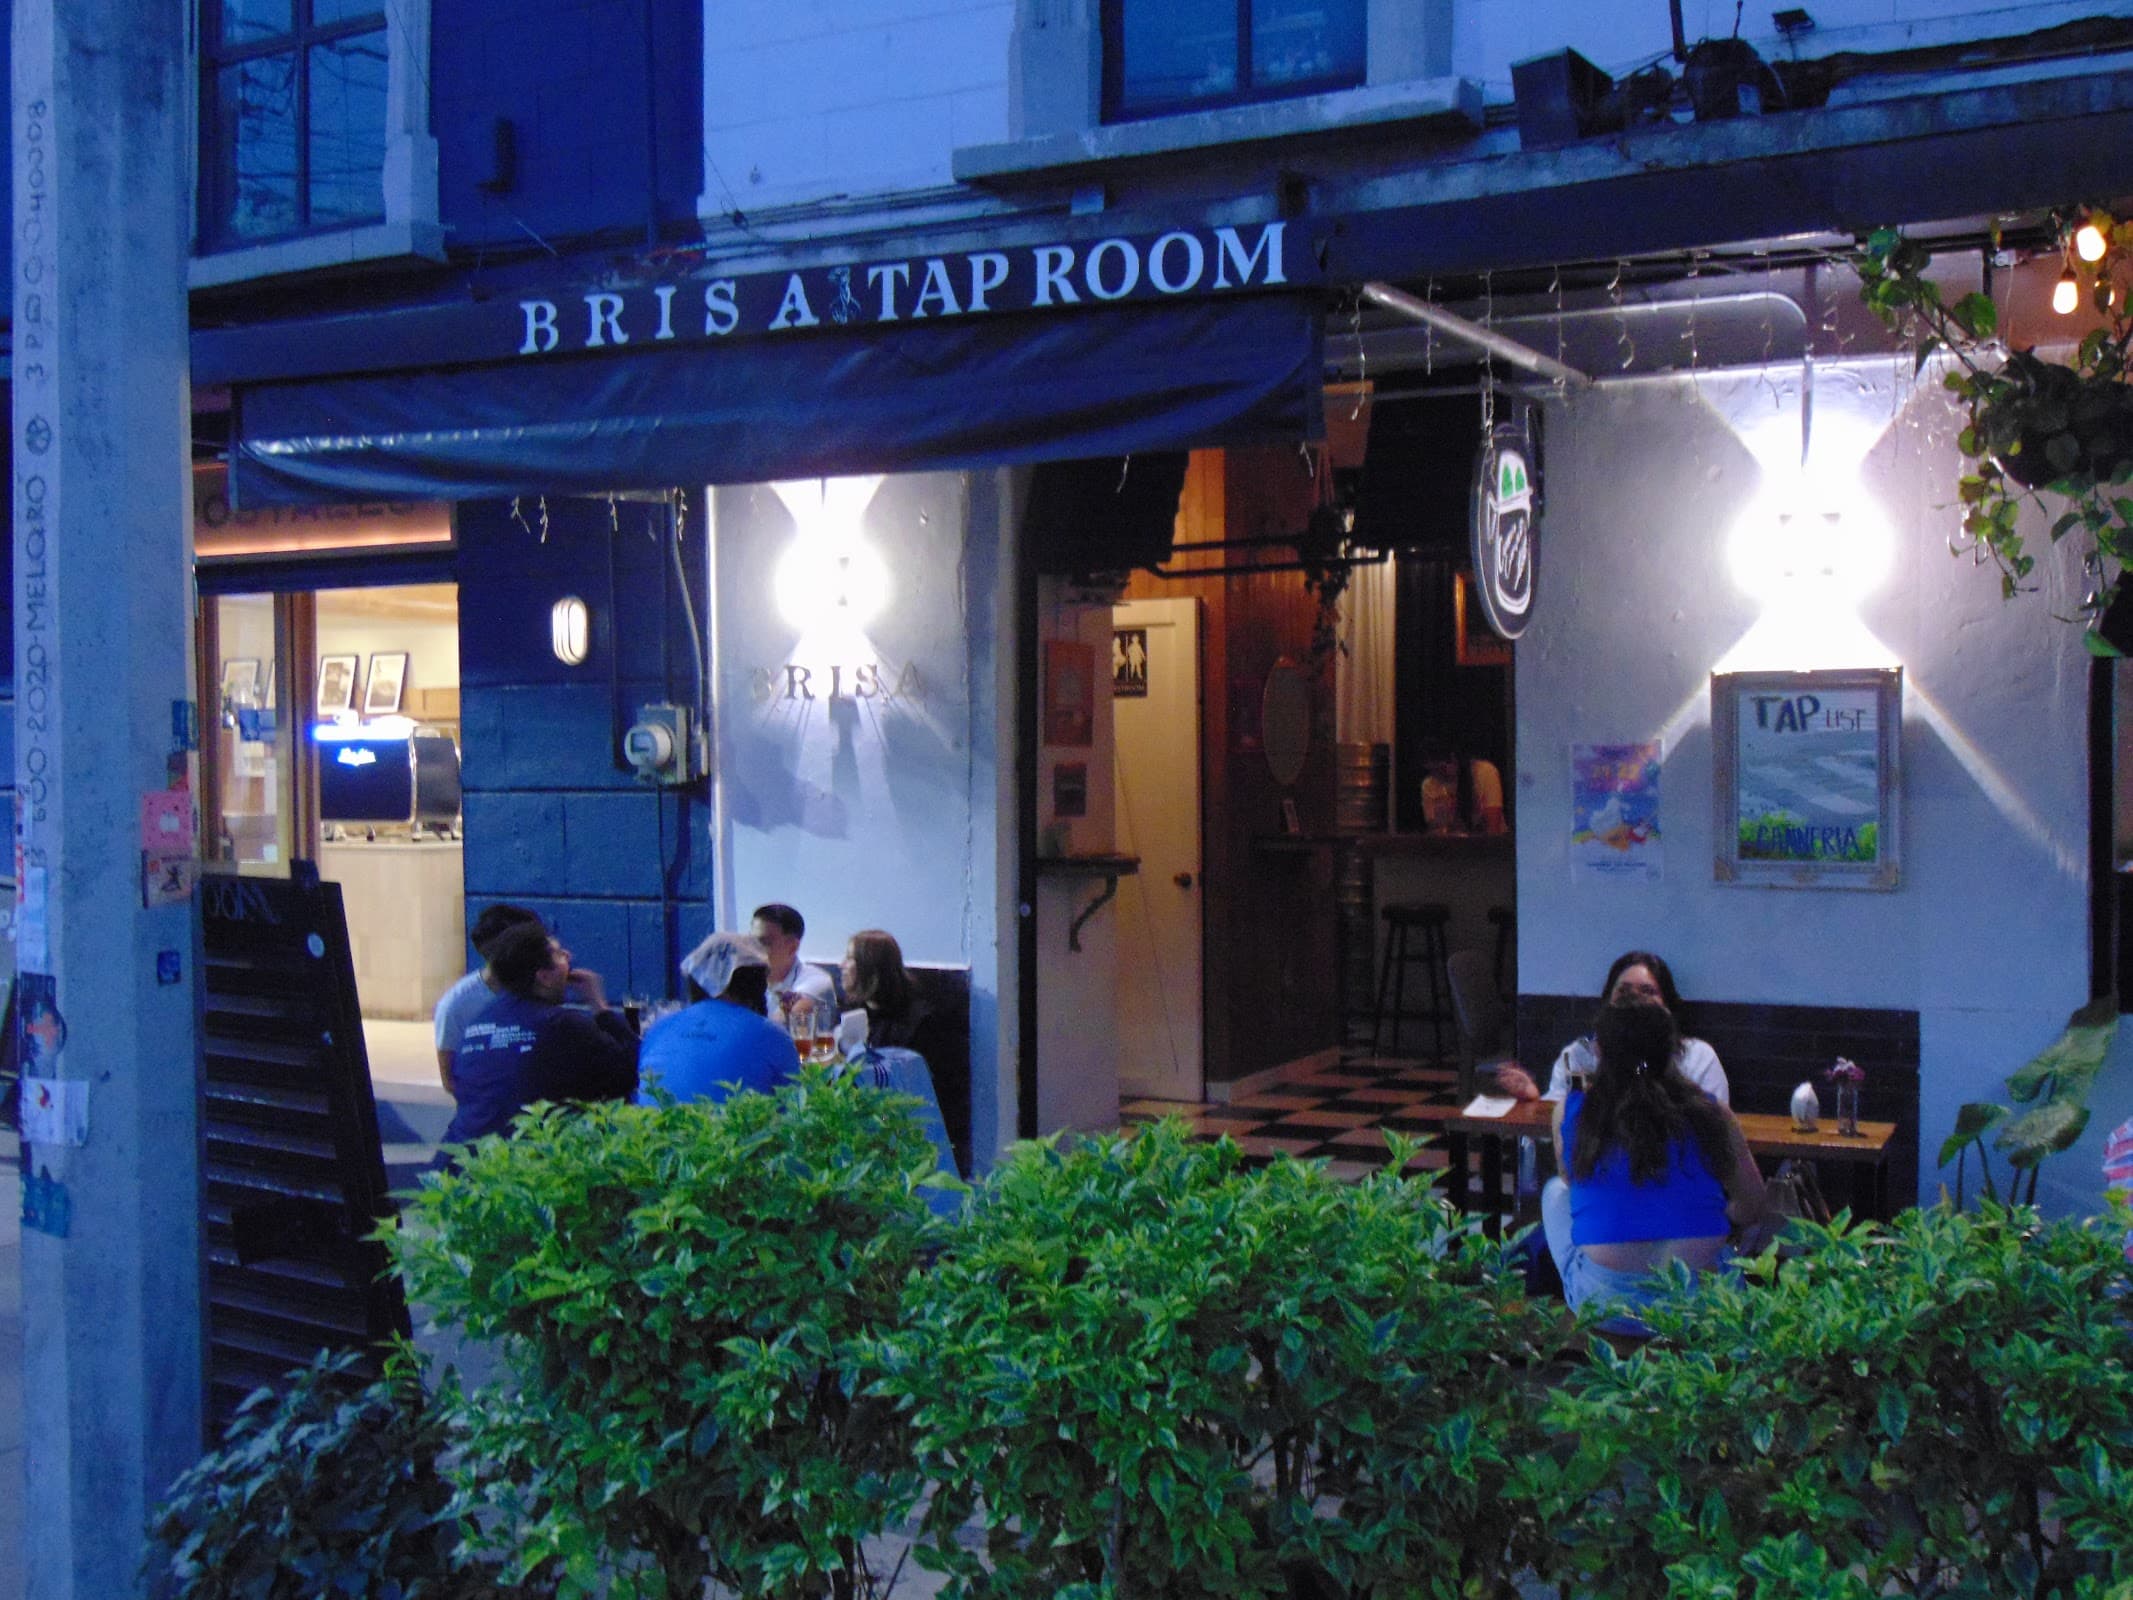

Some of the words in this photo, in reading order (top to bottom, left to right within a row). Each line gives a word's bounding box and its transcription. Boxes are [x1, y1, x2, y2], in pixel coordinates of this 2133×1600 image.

[519, 274, 820, 355] BRISA
[868, 254, 1011, 321] TAP
[1032, 221, 1288, 306] ROOM
[1750, 694, 1821, 733] TAP
